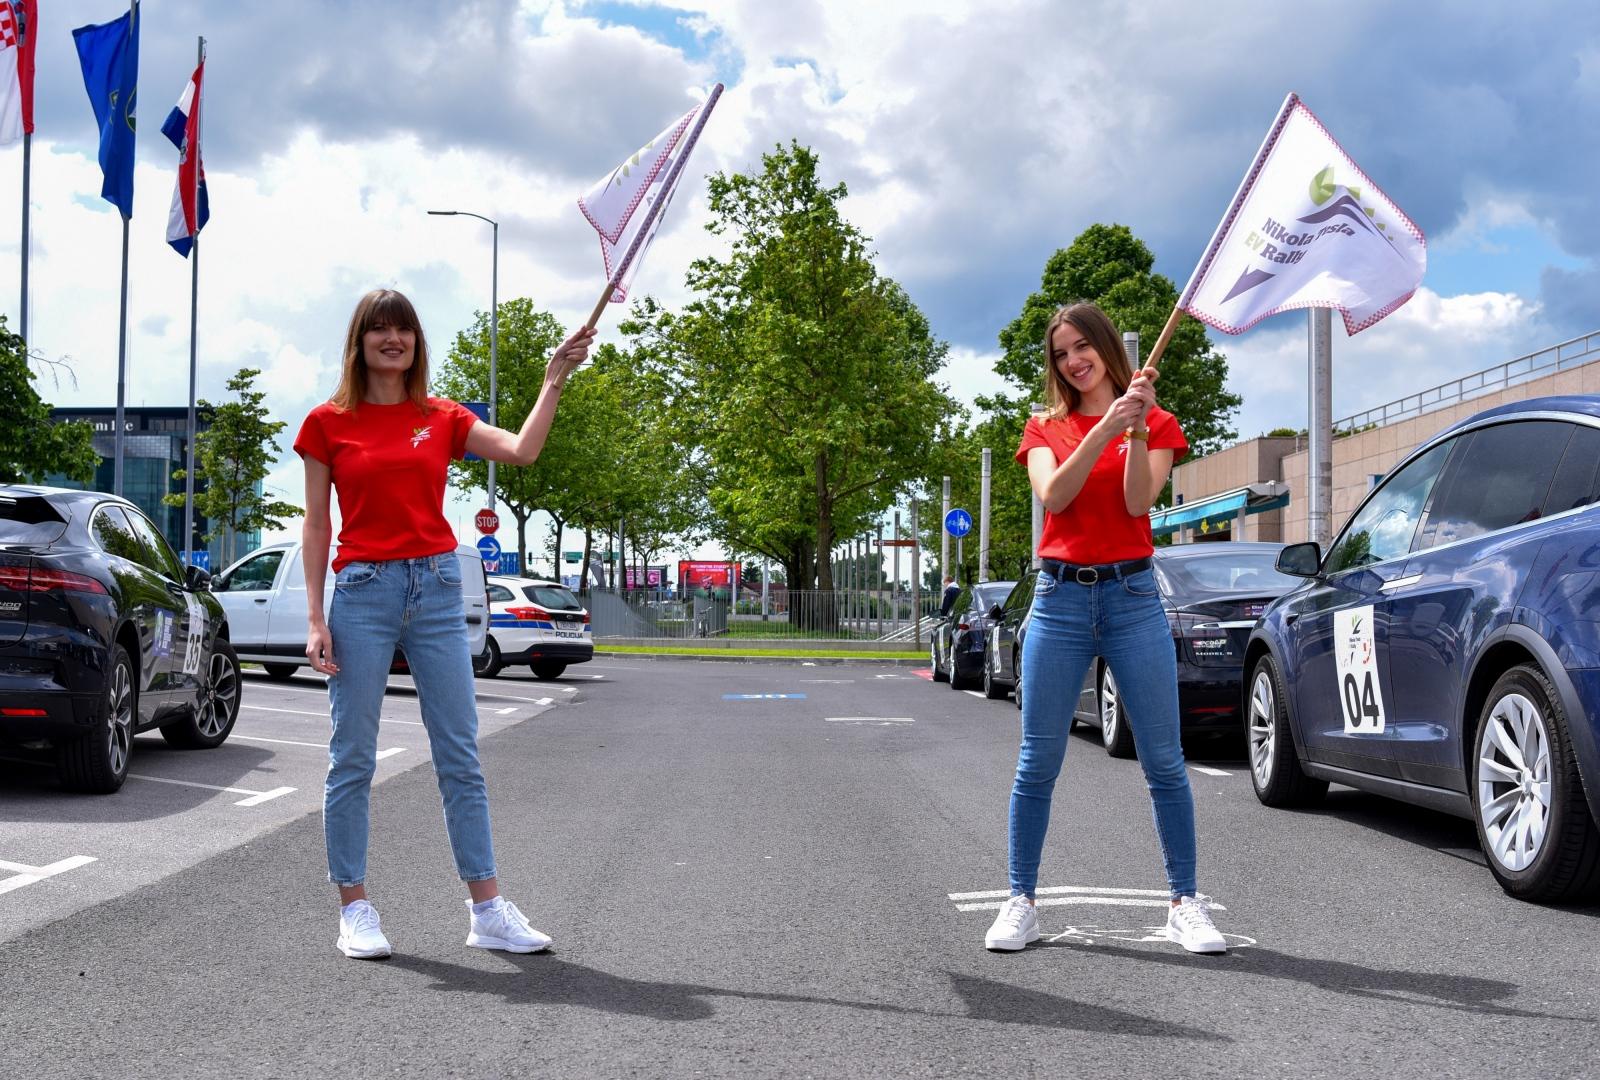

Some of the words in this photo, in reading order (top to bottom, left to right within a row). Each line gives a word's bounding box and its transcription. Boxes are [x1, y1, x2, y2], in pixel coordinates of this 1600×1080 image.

[1244, 231, 1265, 251] EV
[1259, 242, 1308, 264] Rally
[1261, 217, 1315, 246] Nikola
[476, 516, 498, 528] STOP
[186, 633, 201, 670] 35
[1344, 671, 1380, 728] 04
